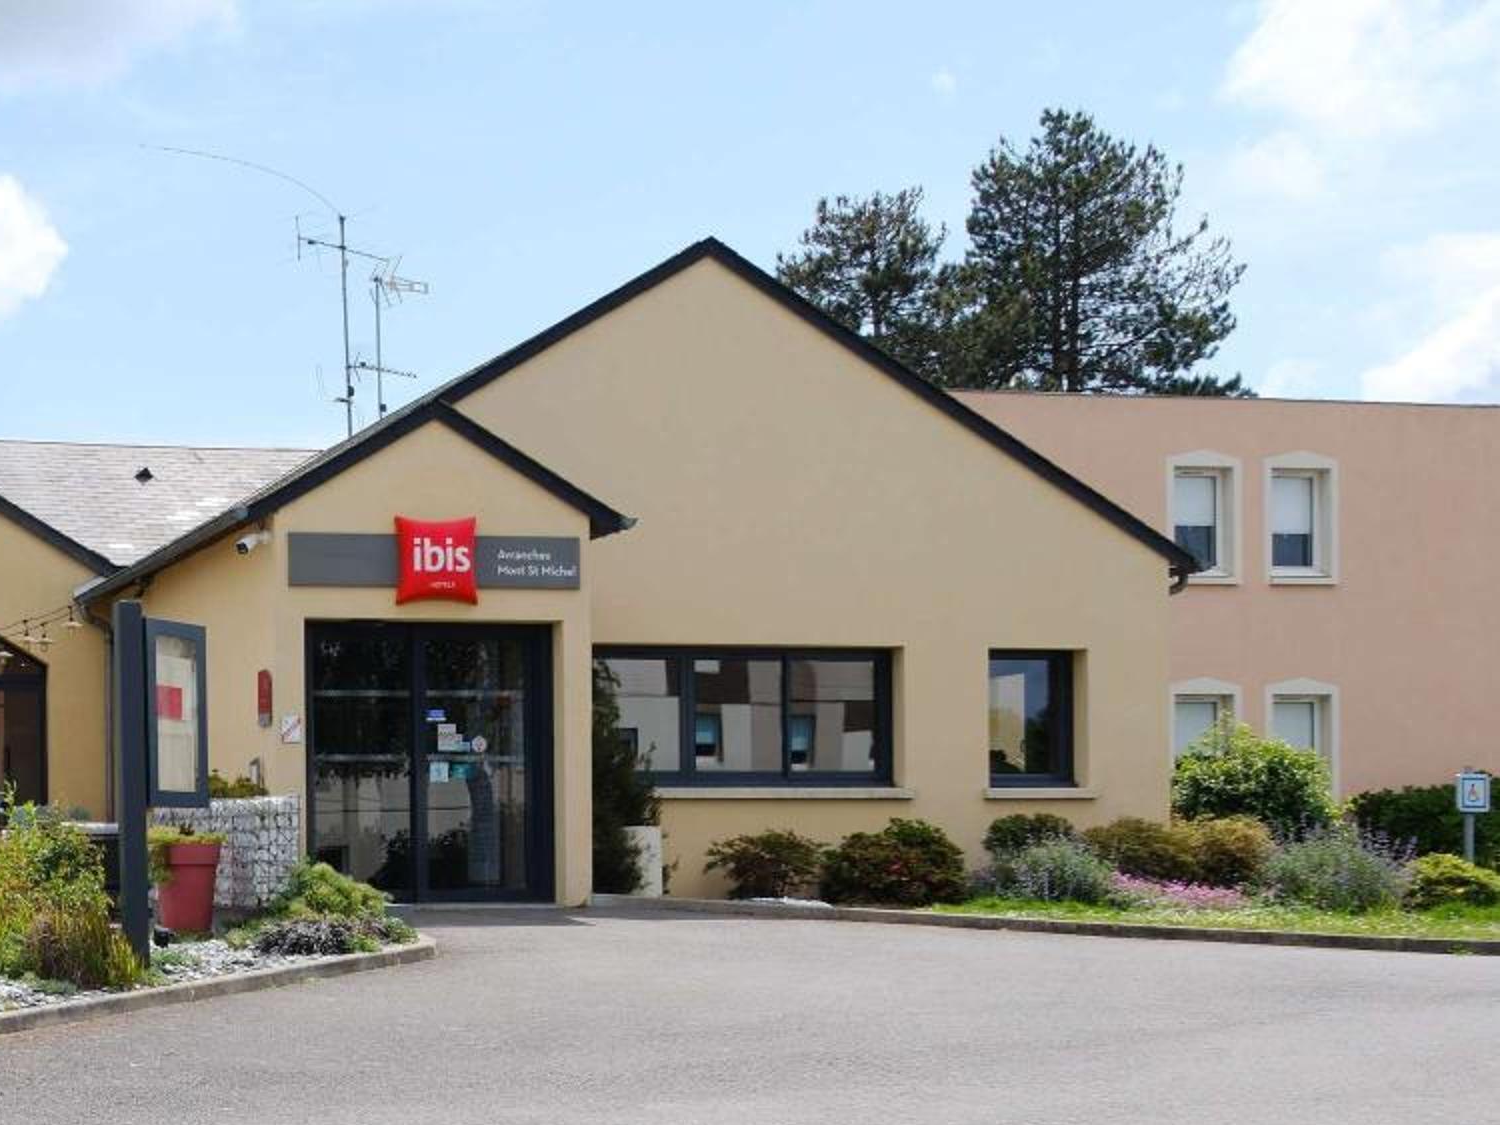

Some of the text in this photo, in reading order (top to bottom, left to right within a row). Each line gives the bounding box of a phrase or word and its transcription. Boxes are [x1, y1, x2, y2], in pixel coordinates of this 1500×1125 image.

[413, 537, 471, 573] ibis
[497, 565, 525, 577] Mont
[541, 565, 577, 577] Michel
